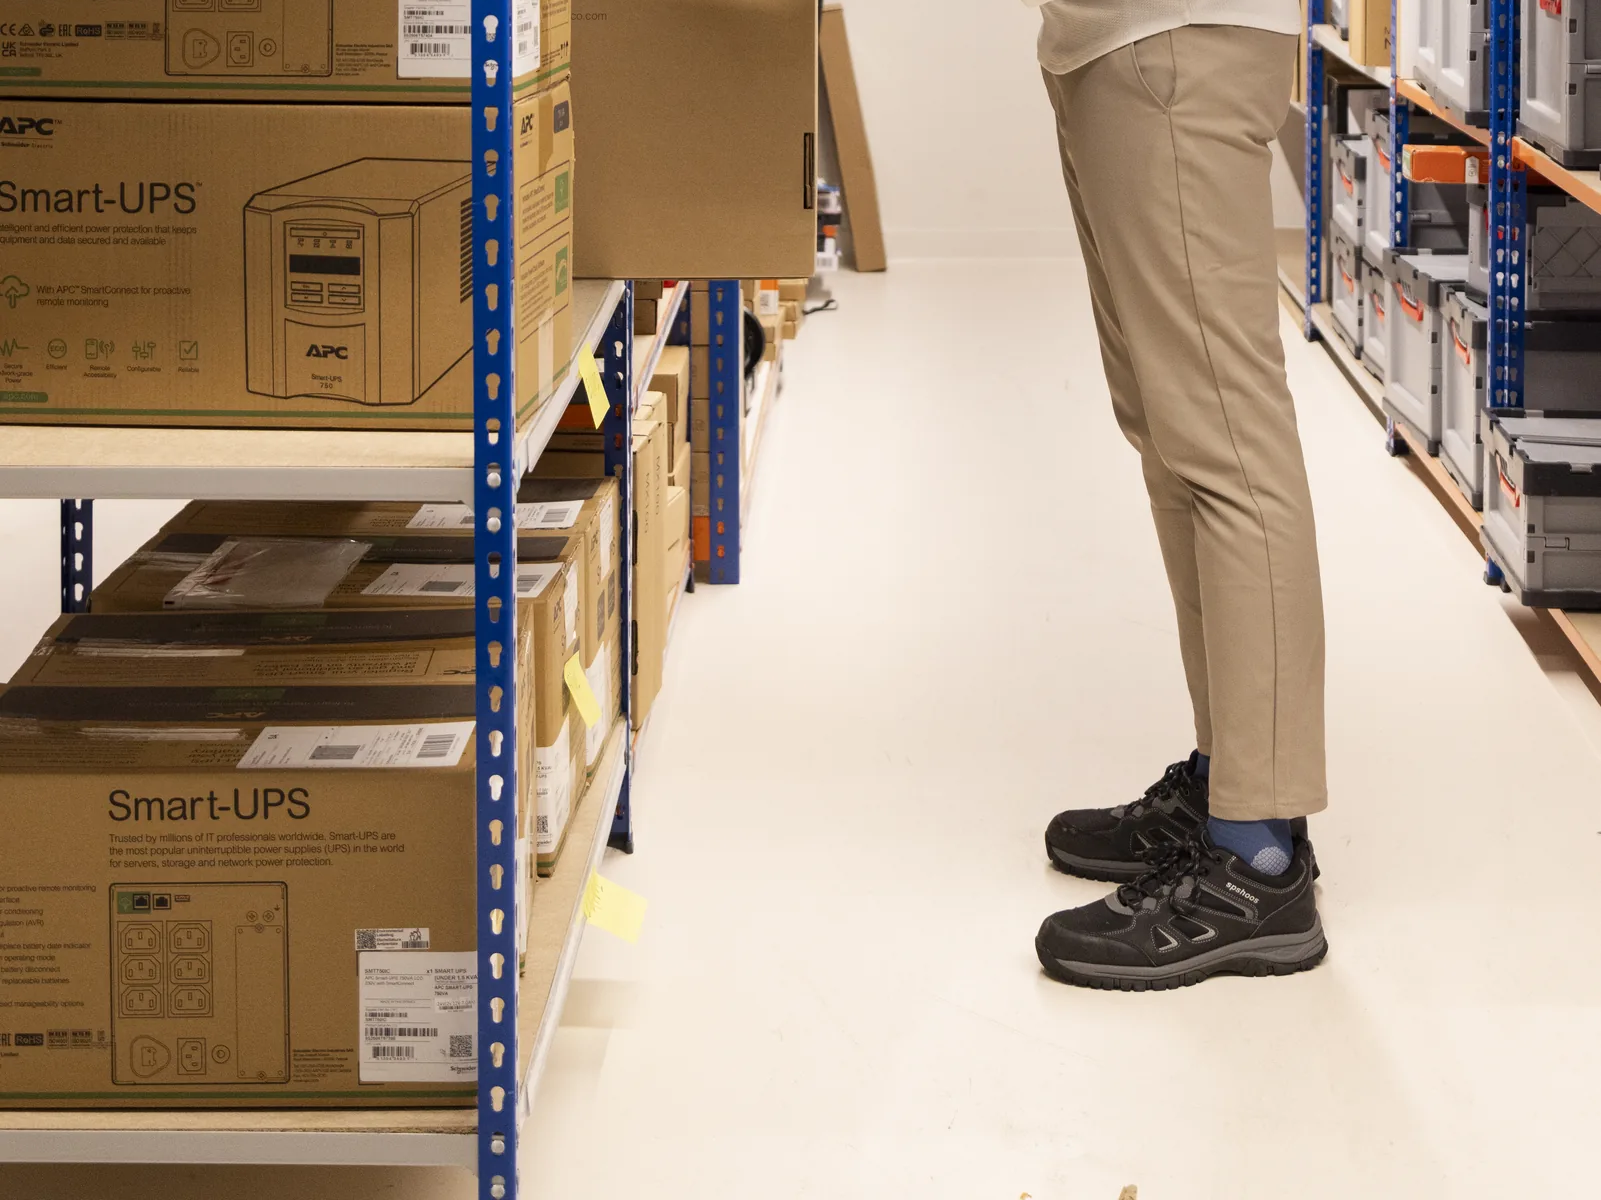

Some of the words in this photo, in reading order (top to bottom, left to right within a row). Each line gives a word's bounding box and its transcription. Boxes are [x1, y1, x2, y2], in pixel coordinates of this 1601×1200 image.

[571, 13, 607, 21] co.com
[0, 223, 32, 234] telligent
[34, 224, 50, 233] and
[51, 224, 84, 233] efficient
[85, 226, 110, 235] power
[112, 225, 154, 235] protection
[155, 225, 170, 234] that
[171, 226, 197, 236] keeps
[0, 236, 38, 246] quipment
[39, 236, 55, 244] and
[57, 236, 75, 245] data
[77, 236, 110, 245] secured
[112, 237, 127, 245] and
[129, 237, 166, 246] available
[36, 285, 55, 294] With
[81, 285, 139, 295] SmartConnect
[140, 286, 152, 295] for
[153, 287, 191, 297] proactive
[37, 298, 65, 307] remote
[66, 298, 109, 309] monitoring
[305, 343, 348, 360] APC
[126, 365, 161, 373] Configurable
[311, 373, 343, 383] Smart-UPS
[108, 787, 311, 821] Smart-UPS
[109, 833, 143, 843] Trusted
[145, 833, 157, 845] by
[159, 833, 192, 843] millions
[194, 832, 204, 842] of
[206, 832, 214, 842] IT
[216, 832, 276, 843] professionals
[328, 831, 378, 841] Smart-UPS
[381, 833, 396, 841] are
[109, 846, 123, 855] the
[125, 846, 147, 855] most
[149, 846, 184, 857] popular
[187, 844, 250, 856] uninterruptible
[253, 846, 281, 856] power
[284, 844, 322, 856] supplies
[324, 843, 351, 854] (UPS)
[353, 843, 361, 853] in
[363, 843, 377, 853] the
[379, 843, 404, 853] world
[109, 858, 121, 868] for
[123, 860, 159, 869] servers,
[161, 859, 196, 870] storage
[198, 857, 215, 867] and
[217, 857, 253, 867] network
[255, 859, 283, 869] power
[285, 857, 333, 868] protection.
[6, 885, 37, 893] proactive
[62, 885, 96, 893] monitoring
[1225, 881, 1260, 904] spshoos
[22, 942, 45, 951] battery
[62, 942, 91, 950] indicator
[4, 954, 35, 963] operating
[36, 954, 55, 962] mode
[25, 965, 60, 974] disconnect
[14, 1000, 58, 1009] manageability
[60, 1001, 84, 1009] options
[16, 1035, 43, 1045] RoHS
